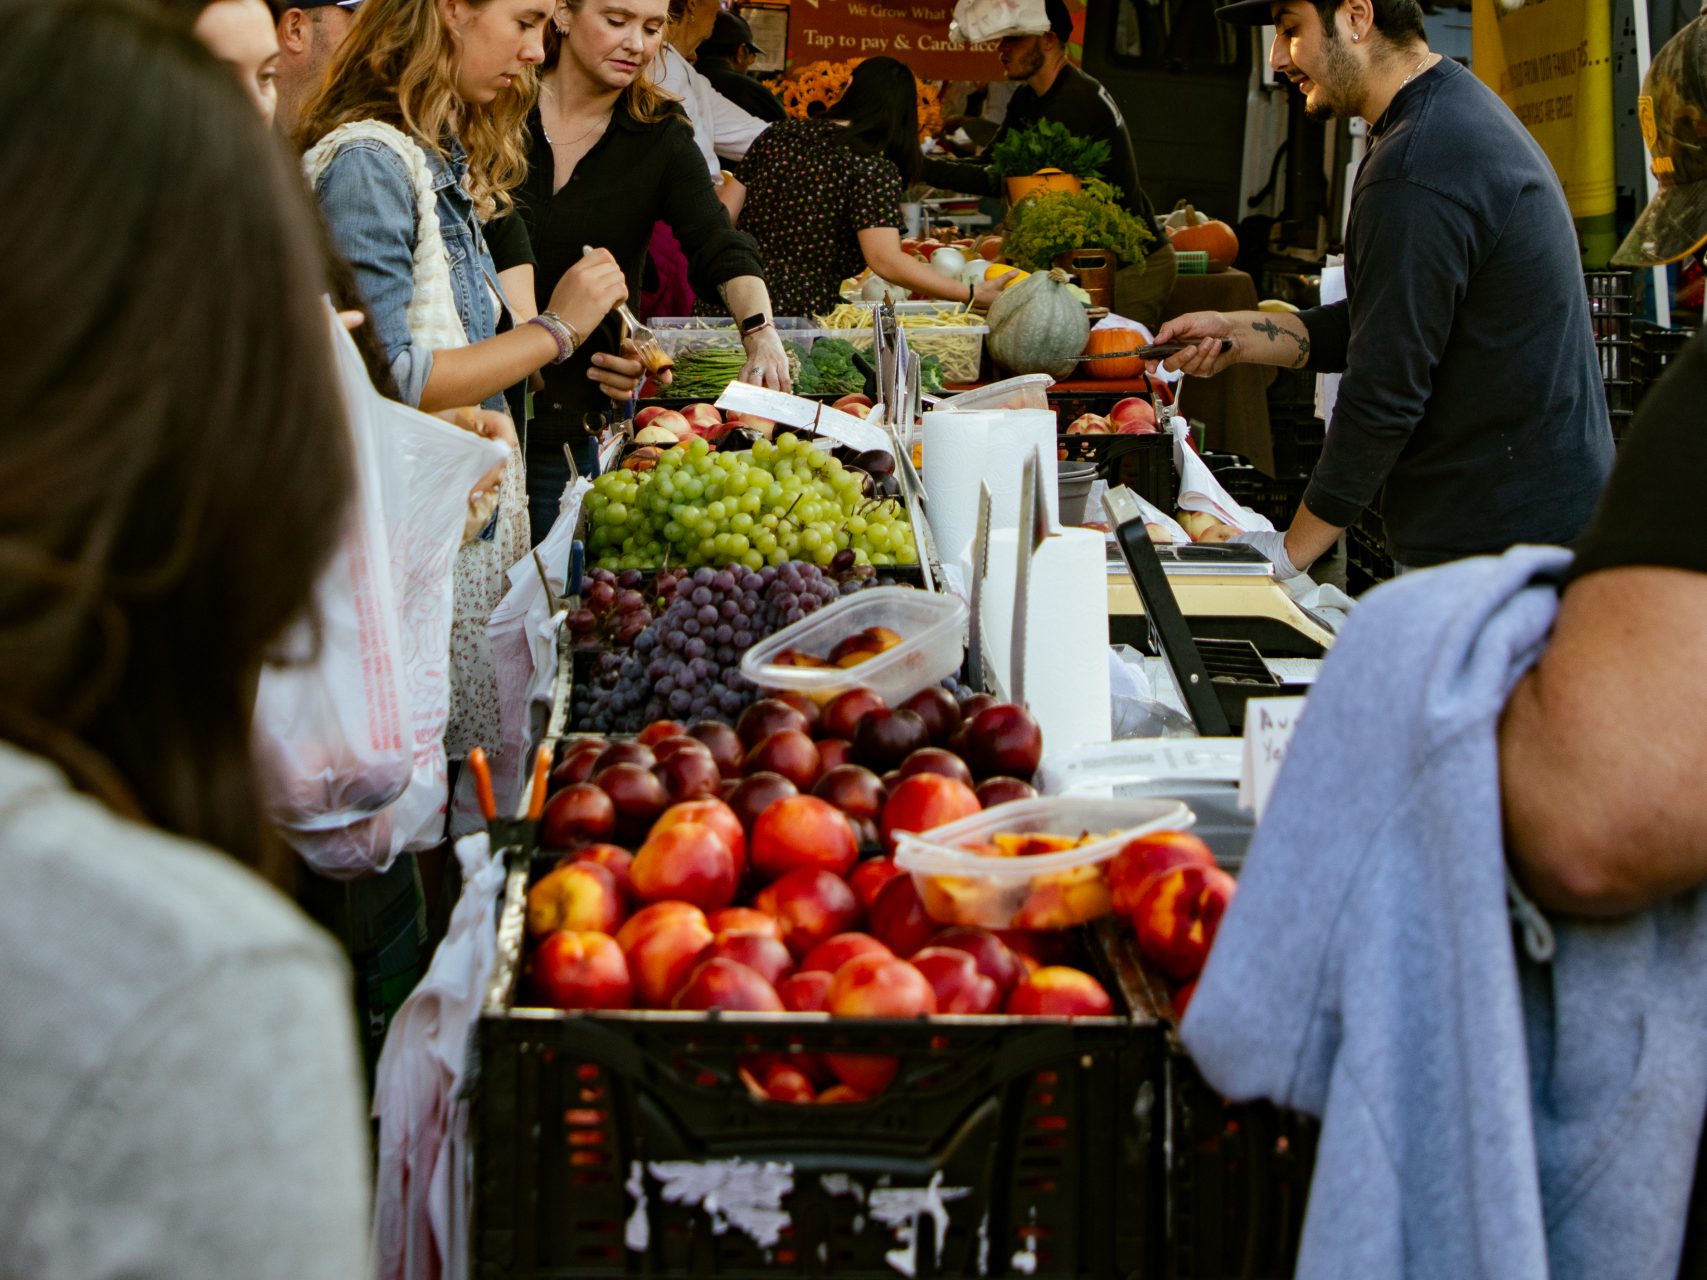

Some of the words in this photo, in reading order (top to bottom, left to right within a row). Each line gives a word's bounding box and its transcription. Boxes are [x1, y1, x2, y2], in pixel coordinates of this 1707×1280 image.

[847, 2, 868, 17] We
[870, 3, 908, 18] Grow
[911, 6, 945, 21] What
[803, 29, 834, 50] Tap
[839, 34, 856, 47] to
[861, 36, 890, 51] pay
[894, 34, 911, 50] &
[917, 34, 965, 52] Cards
